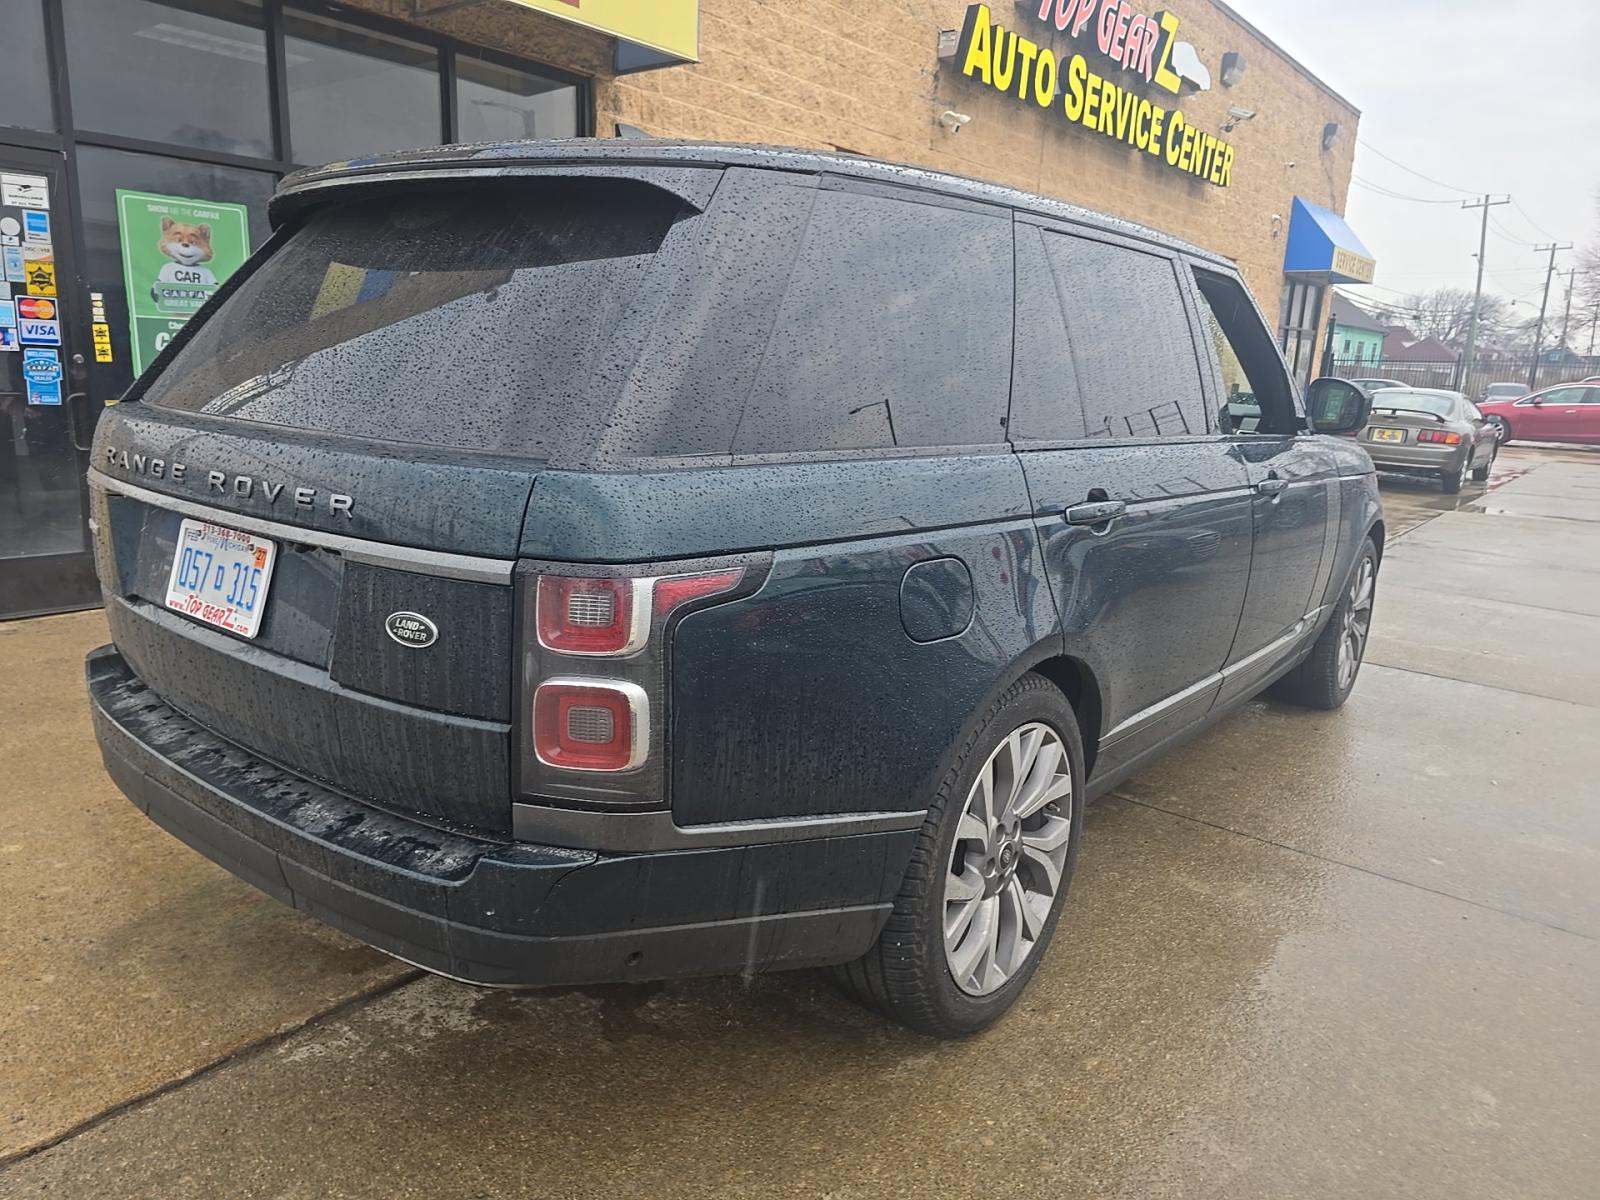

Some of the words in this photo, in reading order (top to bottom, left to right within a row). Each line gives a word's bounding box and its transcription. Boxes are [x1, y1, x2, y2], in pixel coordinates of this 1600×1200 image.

[1097, 0, 1181, 94] GEARZ
[963, 4, 1056, 108] AUTO
[1065, 54, 1165, 155] SERVICE
[1166, 110, 1234, 187] CENTER
[174, 270, 201, 284] CAR
[25, 325, 56, 336] VISA
[105, 446, 187, 482] RANGE
[208, 470, 355, 519] ROVER
[178, 547, 213, 593] 057
[226, 562, 261, 612] 315
[395, 617, 420, 631] LAND
[397, 628, 427, 642] ROVER
